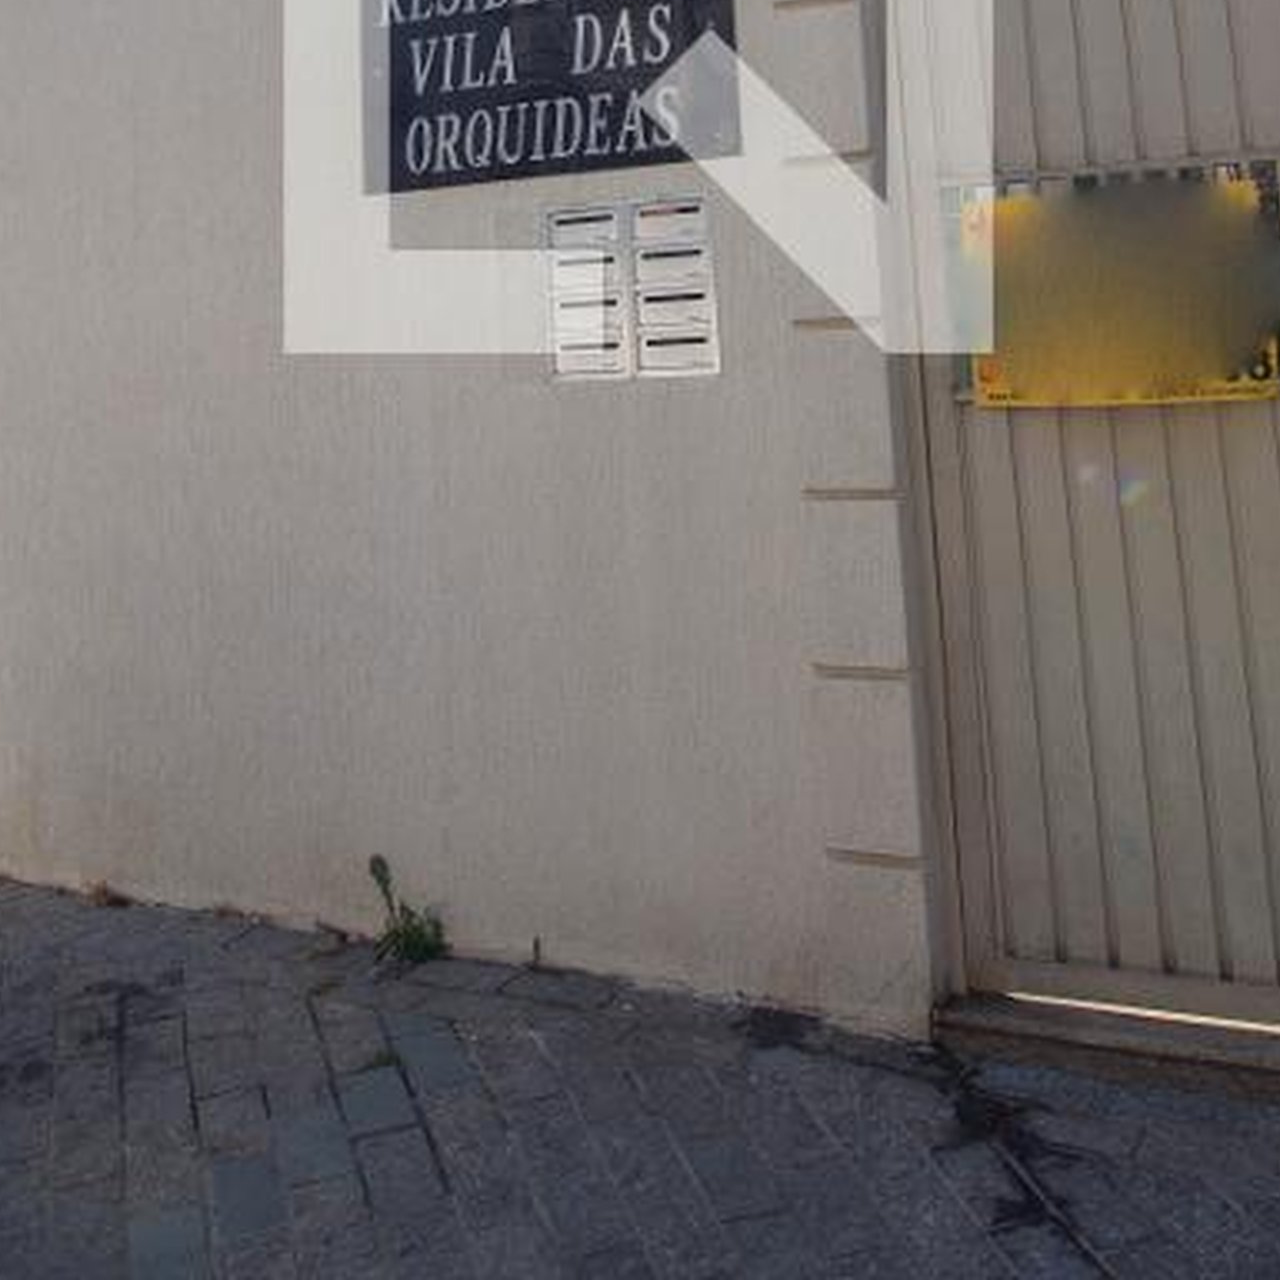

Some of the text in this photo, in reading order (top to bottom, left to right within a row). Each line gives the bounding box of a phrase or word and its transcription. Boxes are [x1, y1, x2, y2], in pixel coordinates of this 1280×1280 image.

[410, 3, 673, 96] VILA DAS
[405, 84, 685, 176] ORQUIDEAS
